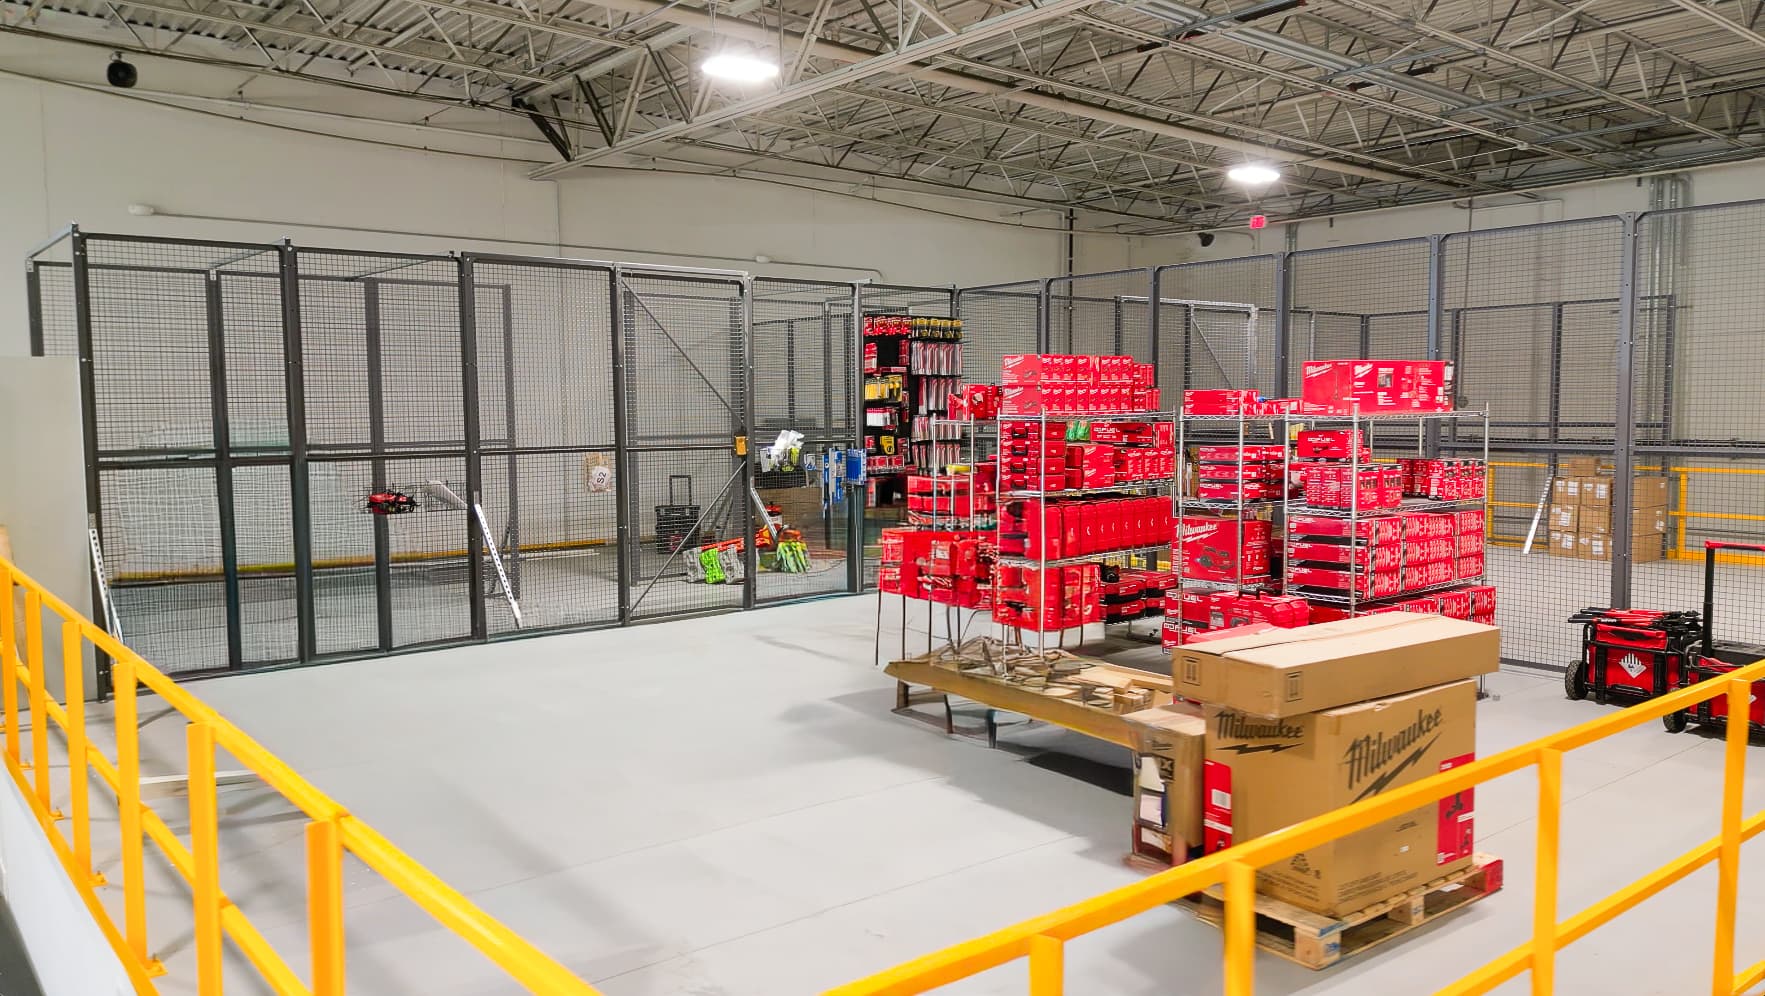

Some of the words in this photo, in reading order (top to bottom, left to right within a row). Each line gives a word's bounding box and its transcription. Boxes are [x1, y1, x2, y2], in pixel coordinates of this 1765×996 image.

[597, 472, 606, 483] S2
[1174, 522, 1217, 538] Milwaukee
[1214, 711, 1304, 740] Milwaukee
[1342, 708, 1443, 790] Milwaukee
